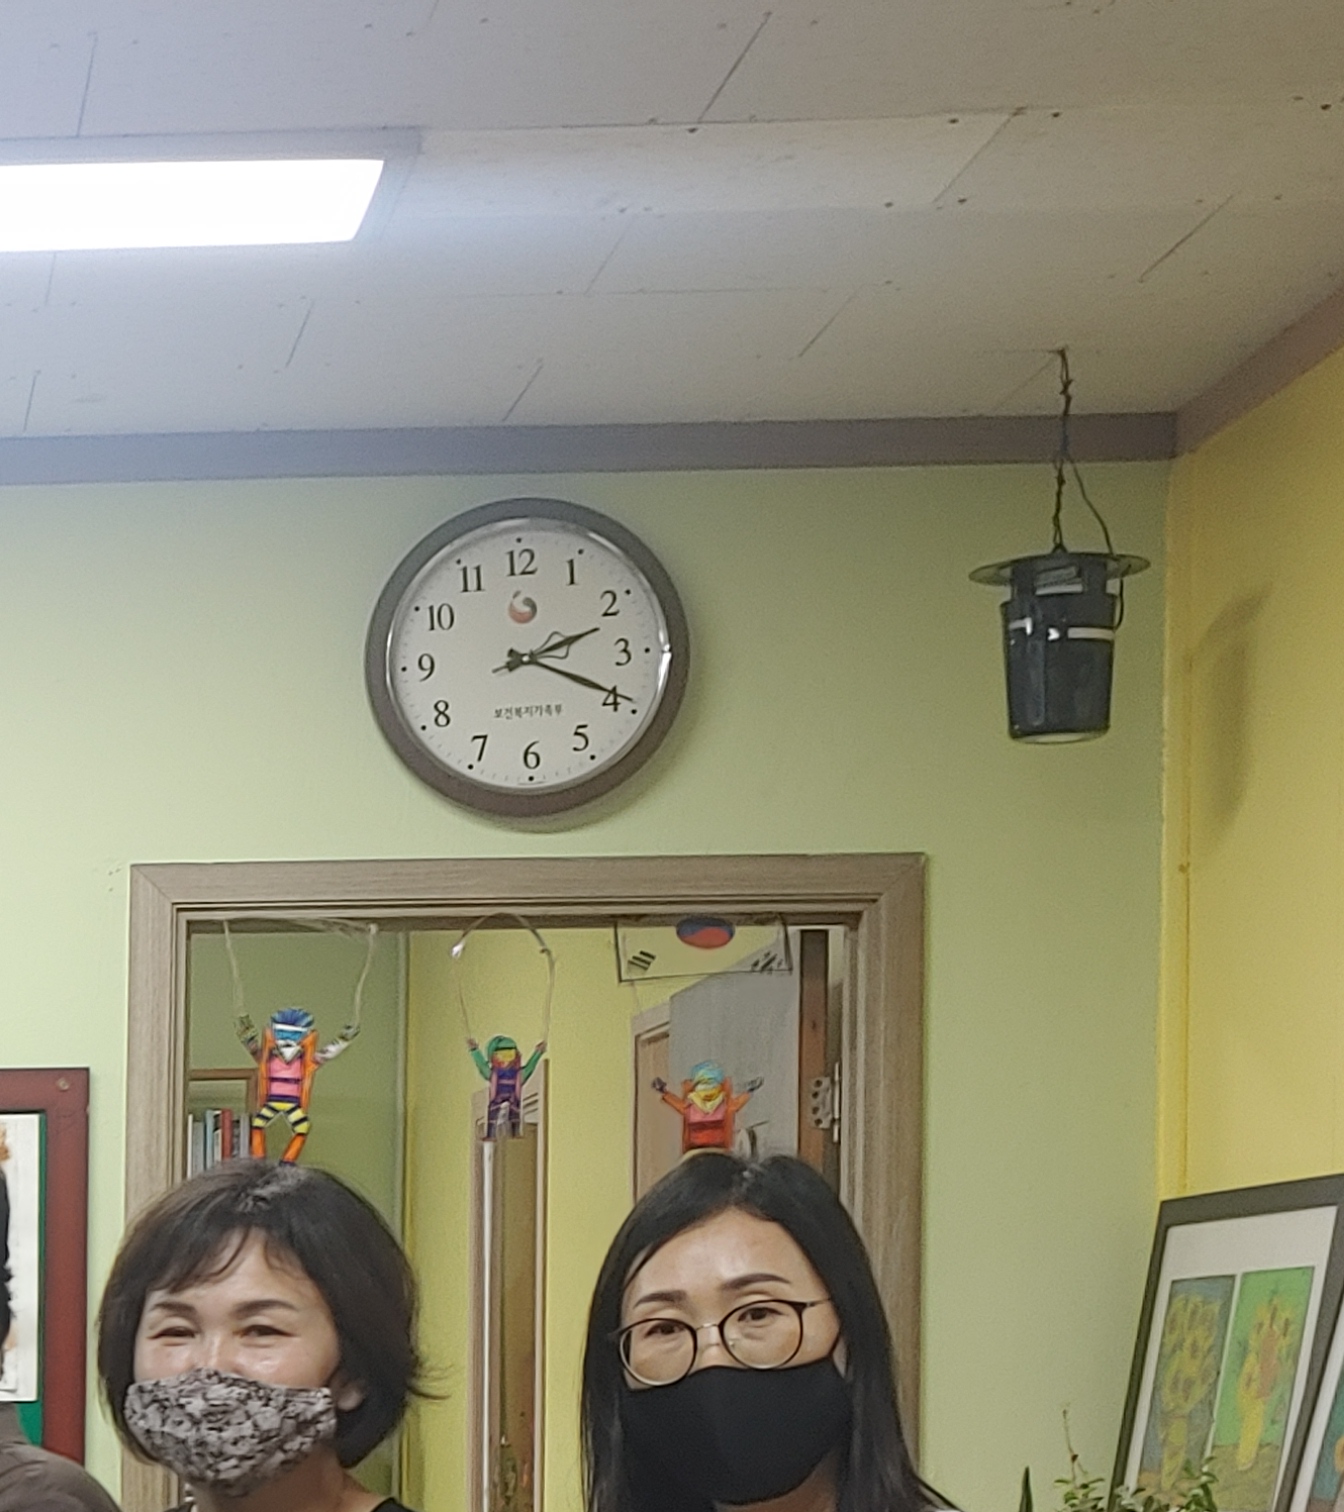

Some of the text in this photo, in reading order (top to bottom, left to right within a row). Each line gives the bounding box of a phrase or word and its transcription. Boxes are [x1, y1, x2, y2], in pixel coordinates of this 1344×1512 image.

[505, 548, 538, 577] 12
[567, 558, 578, 586] 1
[460, 564, 485, 593] 11
[428, 603, 454, 631] 10
[600, 590, 620, 617] 2
[614, 638, 632, 666] 3
[418, 653, 435, 681] 9
[602, 685, 621, 712] 4
[433, 700, 451, 727] 8
[471, 734, 488, 762] 7
[572, 724, 589, 751] 5
[523, 741, 540, 769] 6
